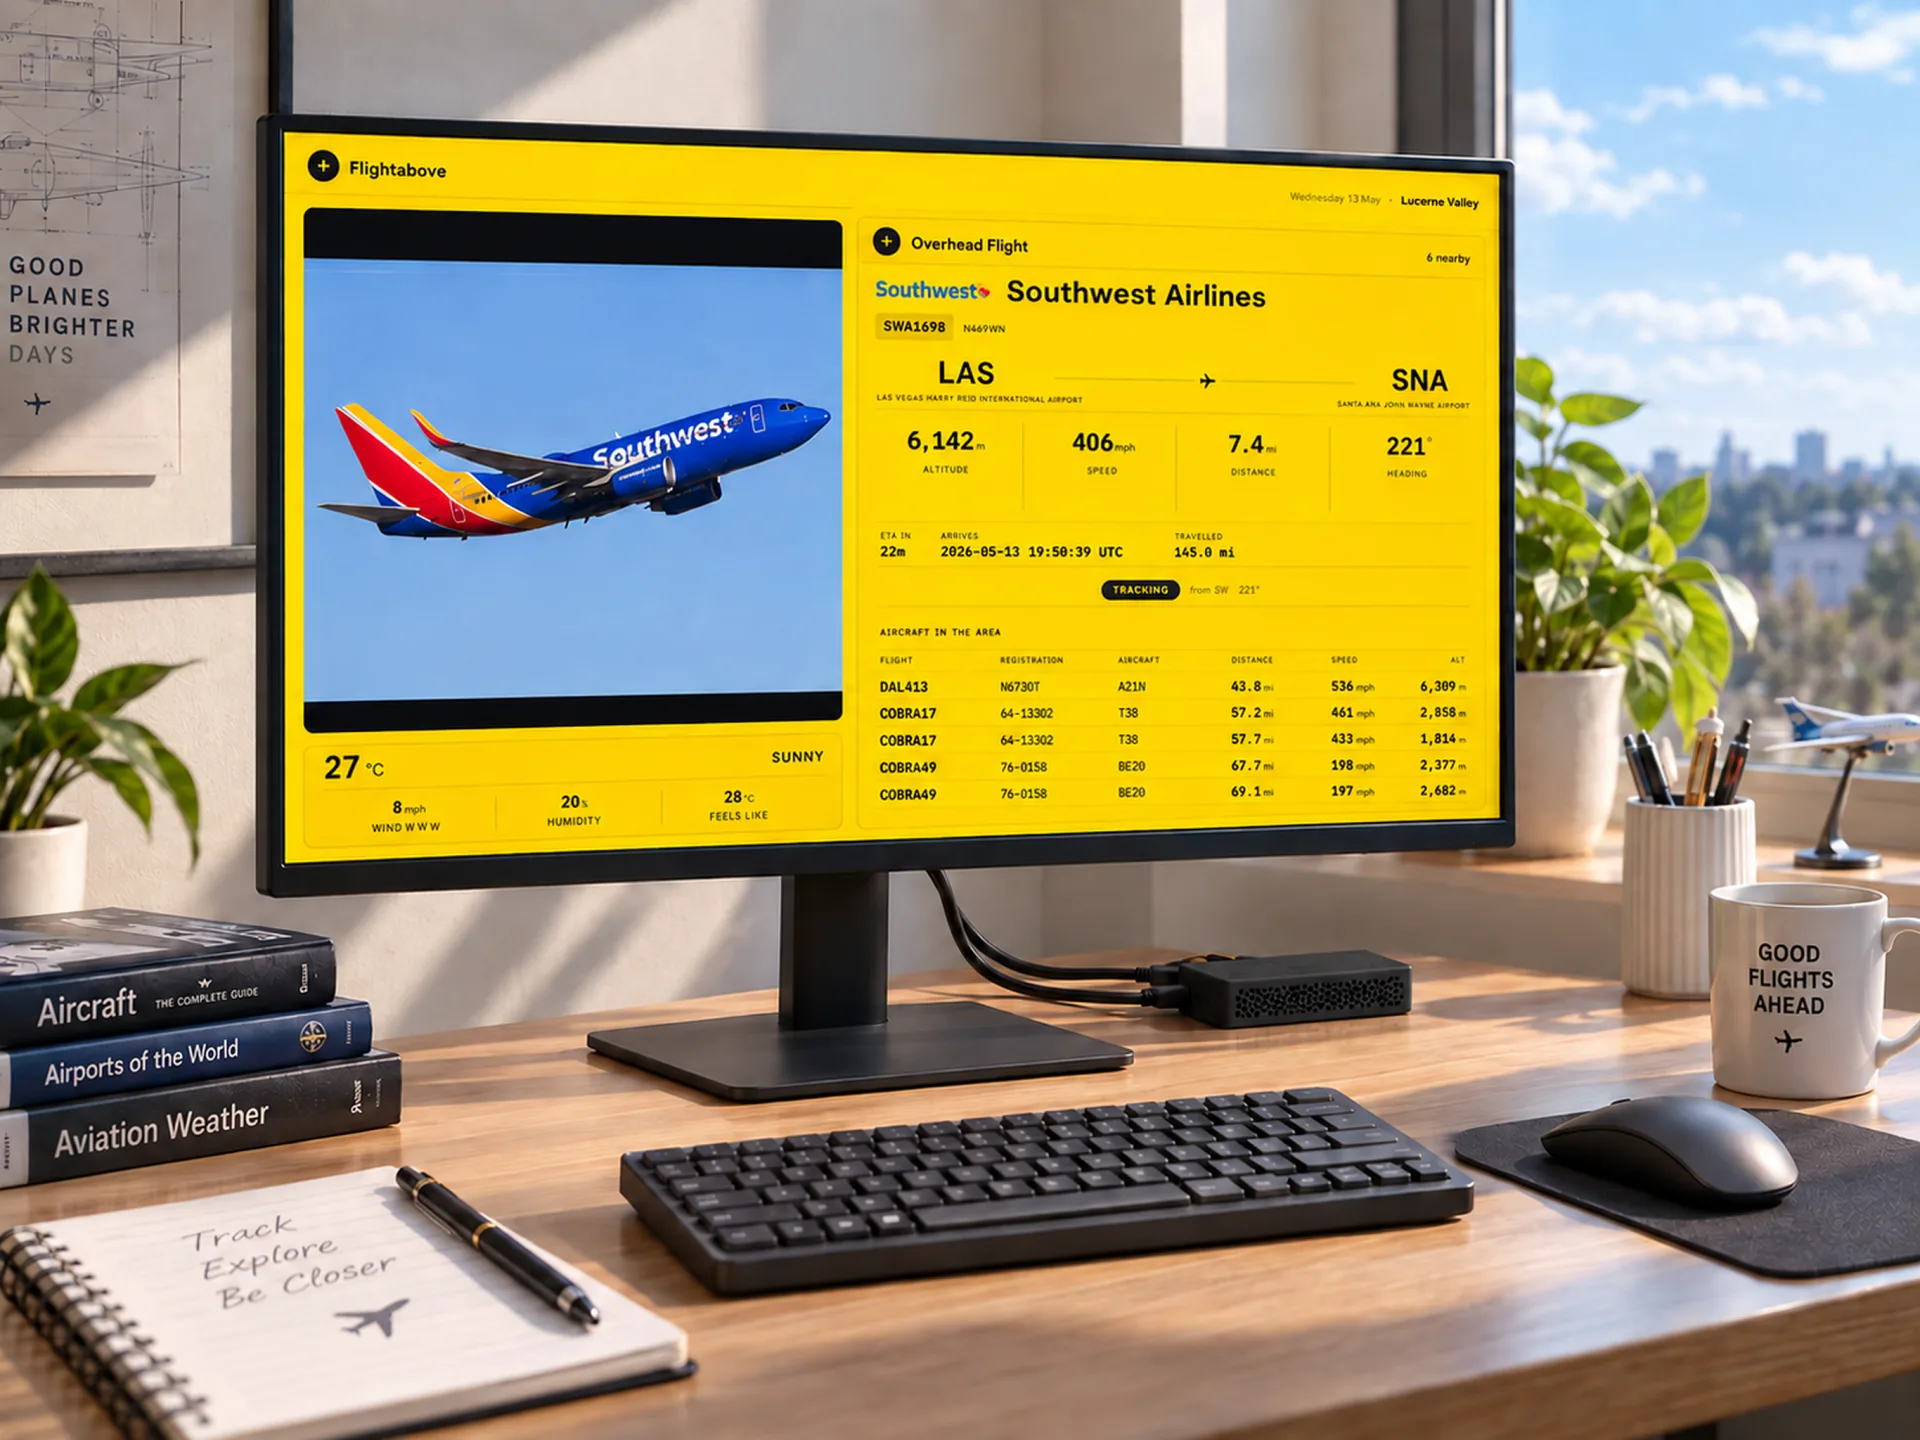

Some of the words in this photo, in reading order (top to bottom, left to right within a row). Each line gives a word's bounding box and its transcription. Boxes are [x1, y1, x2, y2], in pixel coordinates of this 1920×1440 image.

[350, 161, 447, 180] Flightabove
[1290, 192, 1345, 205] Wednesday
[1348, 194, 1359, 203] 13
[1361, 195, 1381, 206] May
[1401, 196, 1445, 206] Lucerne
[1447, 197, 1479, 210] Valley
[911, 236, 983, 251] Overhead
[987, 238, 1028, 256] Flight
[1426, 252, 1433, 262] 6
[1436, 254, 1471, 266] nearby
[9, 256, 84, 277] GOOD
[9, 285, 110, 307] PLANES
[876, 280, 977, 299] Southwest
[1007, 280, 1156, 305] Southwest
[1164, 283, 1266, 308] Airlines
[9, 315, 135, 338] BRIGHTER
[884, 320, 946, 333] SWA1698
[964, 324, 1005, 333] N469WN
[9, 344, 74, 364] DAYS
[939, 360, 994, 385] LAS
[1392, 368, 1448, 392] SNA
[876, 393, 893, 401] LAS
[895, 394, 923, 402] VEGAS
[593, 411, 734, 469] Southwest
[907, 431, 974, 453] 6,142
[1072, 432, 1114, 452] 406
[1229, 434, 1264, 454] 7.4
[923, 465, 968, 474] ALTITUDE
[1087, 466, 1117, 475] SPEED
[1231, 468, 1275, 476] DISTANCE
[1387, 469, 1427, 478] HEADING
[880, 531, 897, 540] ETA
[1175, 533, 1223, 541] TRAVELLED
[880, 545, 906, 557] 22m
[941, 545, 1020, 557] 2026-05-13
[1029, 546, 1091, 558] 19:50:39
[1099, 546, 1123, 558] UTC
[1175, 546, 1212, 558] 145.0
[1219, 546, 1235, 558] mi
[1113, 585, 1169, 595] TRACKING
[1190, 585, 1211, 594] from
[1214, 585, 1229, 594] SW
[880, 628, 930, 636] AIRCRAFT
[935, 628, 947, 637] IN
[952, 628, 970, 637] THE
[976, 628, 1001, 637] AREA
[880, 656, 912, 664] FLIGHT
[1000, 656, 1063, 664] REGISTRATION
[1231, 656, 1273, 664] DISTANCE
[1331, 656, 1358, 664] SPEED
[1450, 656, 1465, 664] ALT
[880, 681, 928, 693] DAL413
[1001, 681, 1040, 692] N6730T
[1118, 681, 1146, 692] A21N
[1231, 680, 1262, 692] 43.8
[1331, 680, 1354, 692] 536
[1356, 683, 1375, 693] mph
[1420, 680, 1456, 694] 6,309
[880, 707, 937, 719] COBRA17
[1001, 708, 1053, 719] 64-13302
[1119, 707, 1138, 718] T38
[1231, 706, 1261, 718] 57.2
[1331, 706, 1354, 718] 461
[1356, 709, 1375, 720] mph
[1420, 706, 1456, 720] 2,858
[880, 734, 937, 746] COBRA17
[1000, 734, 1054, 746] 64-13302
[1118, 734, 1138, 745] T38
[1231, 733, 1261, 745] 57.7
[1331, 733, 1353, 744] 433
[1356, 736, 1375, 746] mph
[1421, 733, 1456, 746] 1,814
[772, 750, 824, 763] SUNNY
[325, 755, 360, 780] 27
[879, 761, 937, 774] COBRA49
[1001, 761, 1047, 772] 76-0158
[1118, 761, 1146, 772] BE20
[1231, 760, 1261, 771] 67.7
[1331, 759, 1354, 771] 198
[1355, 762, 1375, 772] mph
[1420, 759, 1456, 772] 2,377
[724, 790, 742, 803] 28
[880, 789, 937, 801] COBRA49
[1001, 788, 1048, 799] 76-0158
[1118, 787, 1146, 798] BE20
[1231, 786, 1261, 797] 69.1
[1331, 785, 1353, 796] 197
[1356, 788, 1375, 798] mph
[1420, 784, 1456, 798] 2,682
[393, 800, 402, 814] 8
[404, 804, 426, 816] mph
[561, 795, 580, 808] 20
[547, 816, 601, 826] HUMIDITY
[710, 811, 741, 821] FEELS
[745, 810, 768, 820] LIKE
[372, 823, 402, 832] WIND
[1758, 943, 1820, 962] GOOD
[1749, 968, 1834, 989] FLIGHTS
[155, 997, 174, 1009] THE
[177, 991, 227, 1007] COMPLETE
[231, 987, 259, 1000] GUIDE
[1753, 994, 1824, 1015] AHEAD
[37, 988, 137, 1027] Aircraft
[44, 1058, 124, 1086] Airports
[129, 1053, 149, 1072] of
[153, 1048, 183, 1068] the
[188, 1038, 239, 1064] World
[54, 1121, 158, 1158] Aviation
[166, 1103, 270, 1140] Weather
[183, 1215, 297, 1252] Track
[202, 1237, 338, 1281] Explore
[217, 1287, 266, 1310] Be
[283, 1257, 397, 1295] Closer
